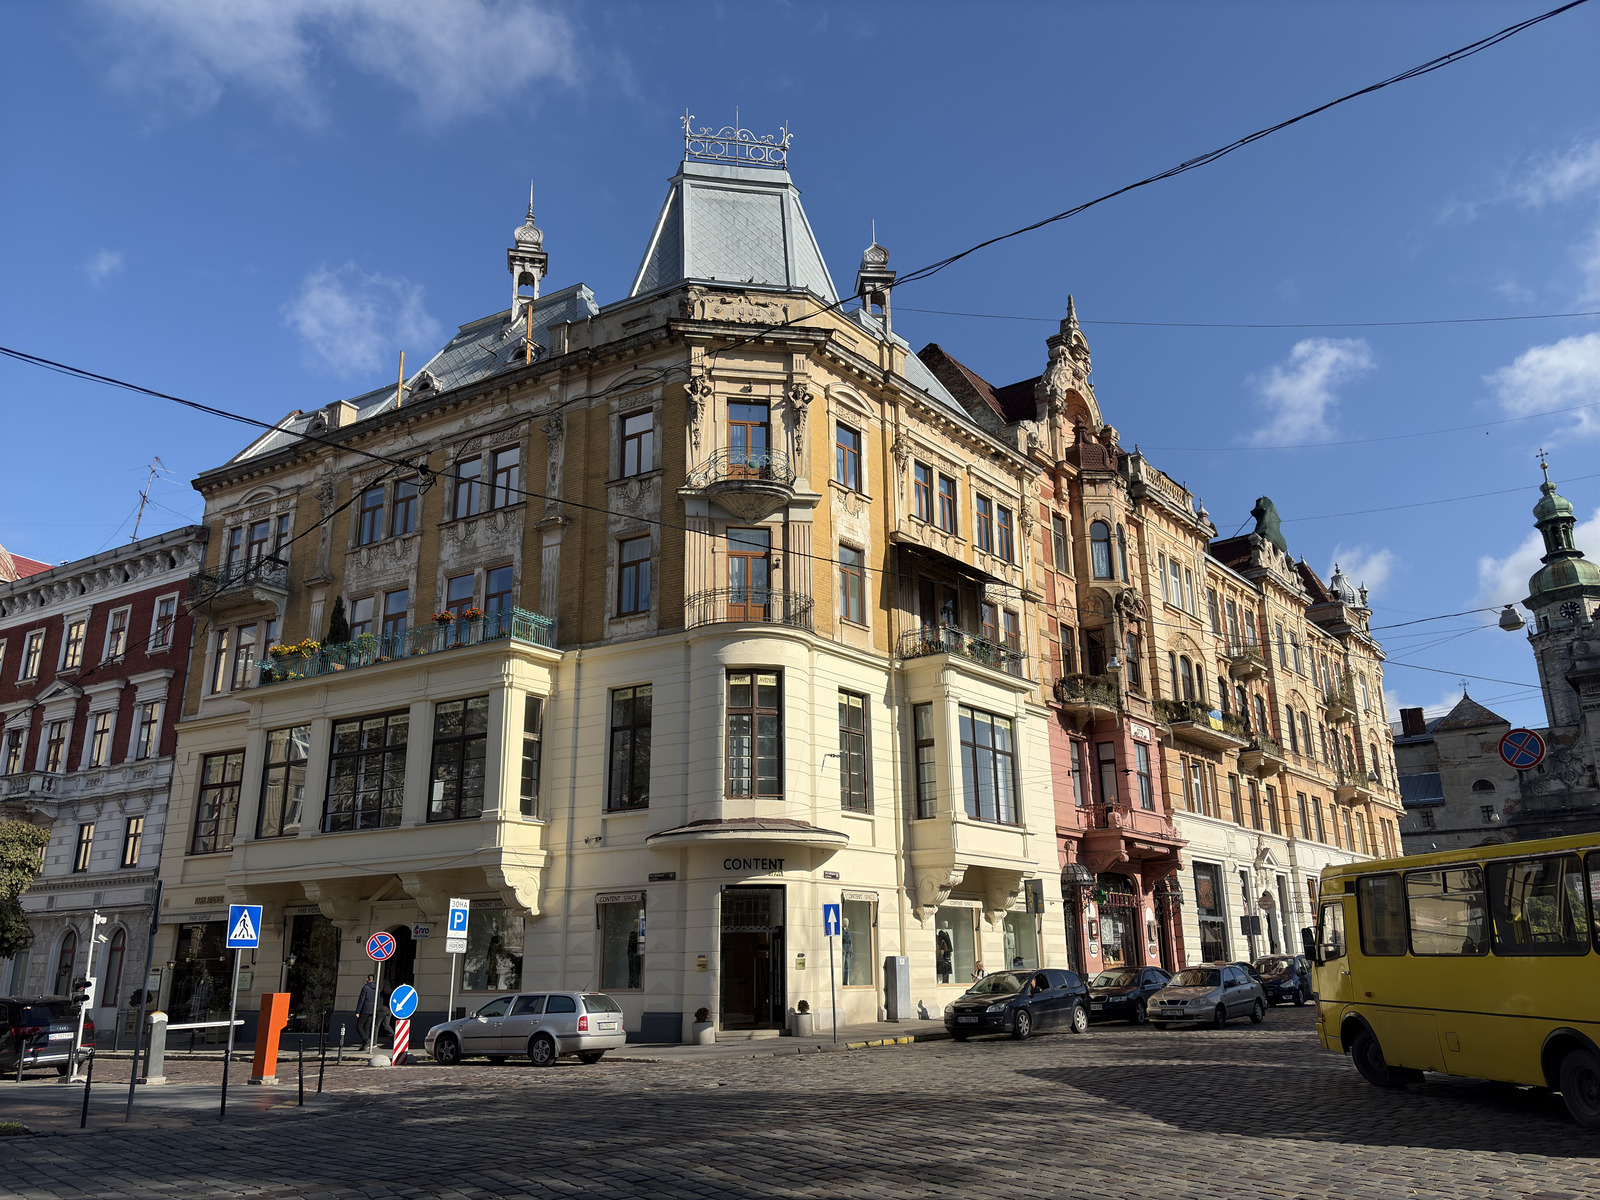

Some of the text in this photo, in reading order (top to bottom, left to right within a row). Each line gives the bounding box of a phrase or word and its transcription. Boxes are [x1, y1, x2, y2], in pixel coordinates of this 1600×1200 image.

[723, 858, 785, 871] CONTENT
[451, 900, 468, 909] ЗОНА
[453, 911, 464, 929] P
